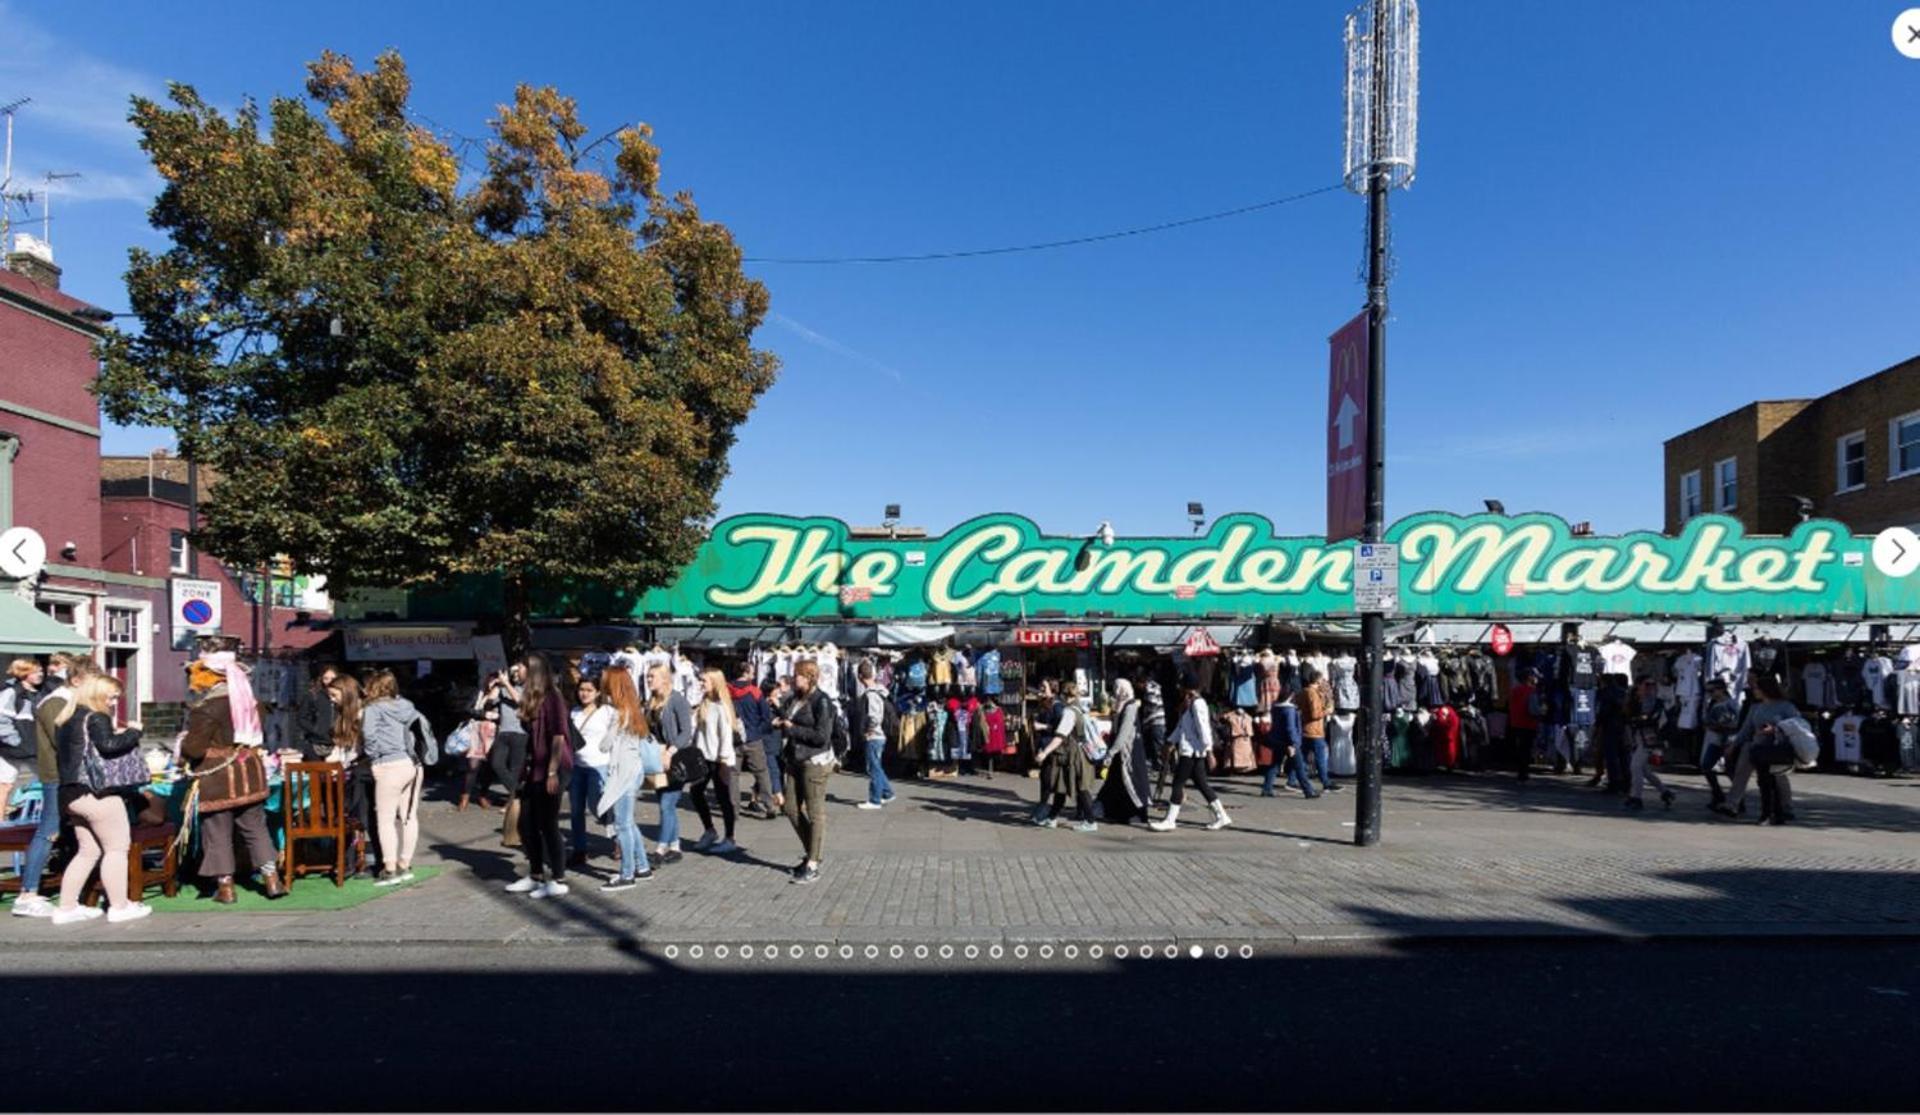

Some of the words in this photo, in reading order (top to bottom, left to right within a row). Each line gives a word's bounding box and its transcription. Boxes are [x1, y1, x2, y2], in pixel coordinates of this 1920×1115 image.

[709, 525, 898, 606] The
[928, 524, 1355, 612] Camden
[1400, 522, 1835, 593] Market
[417, 633, 469, 647] Chicken
